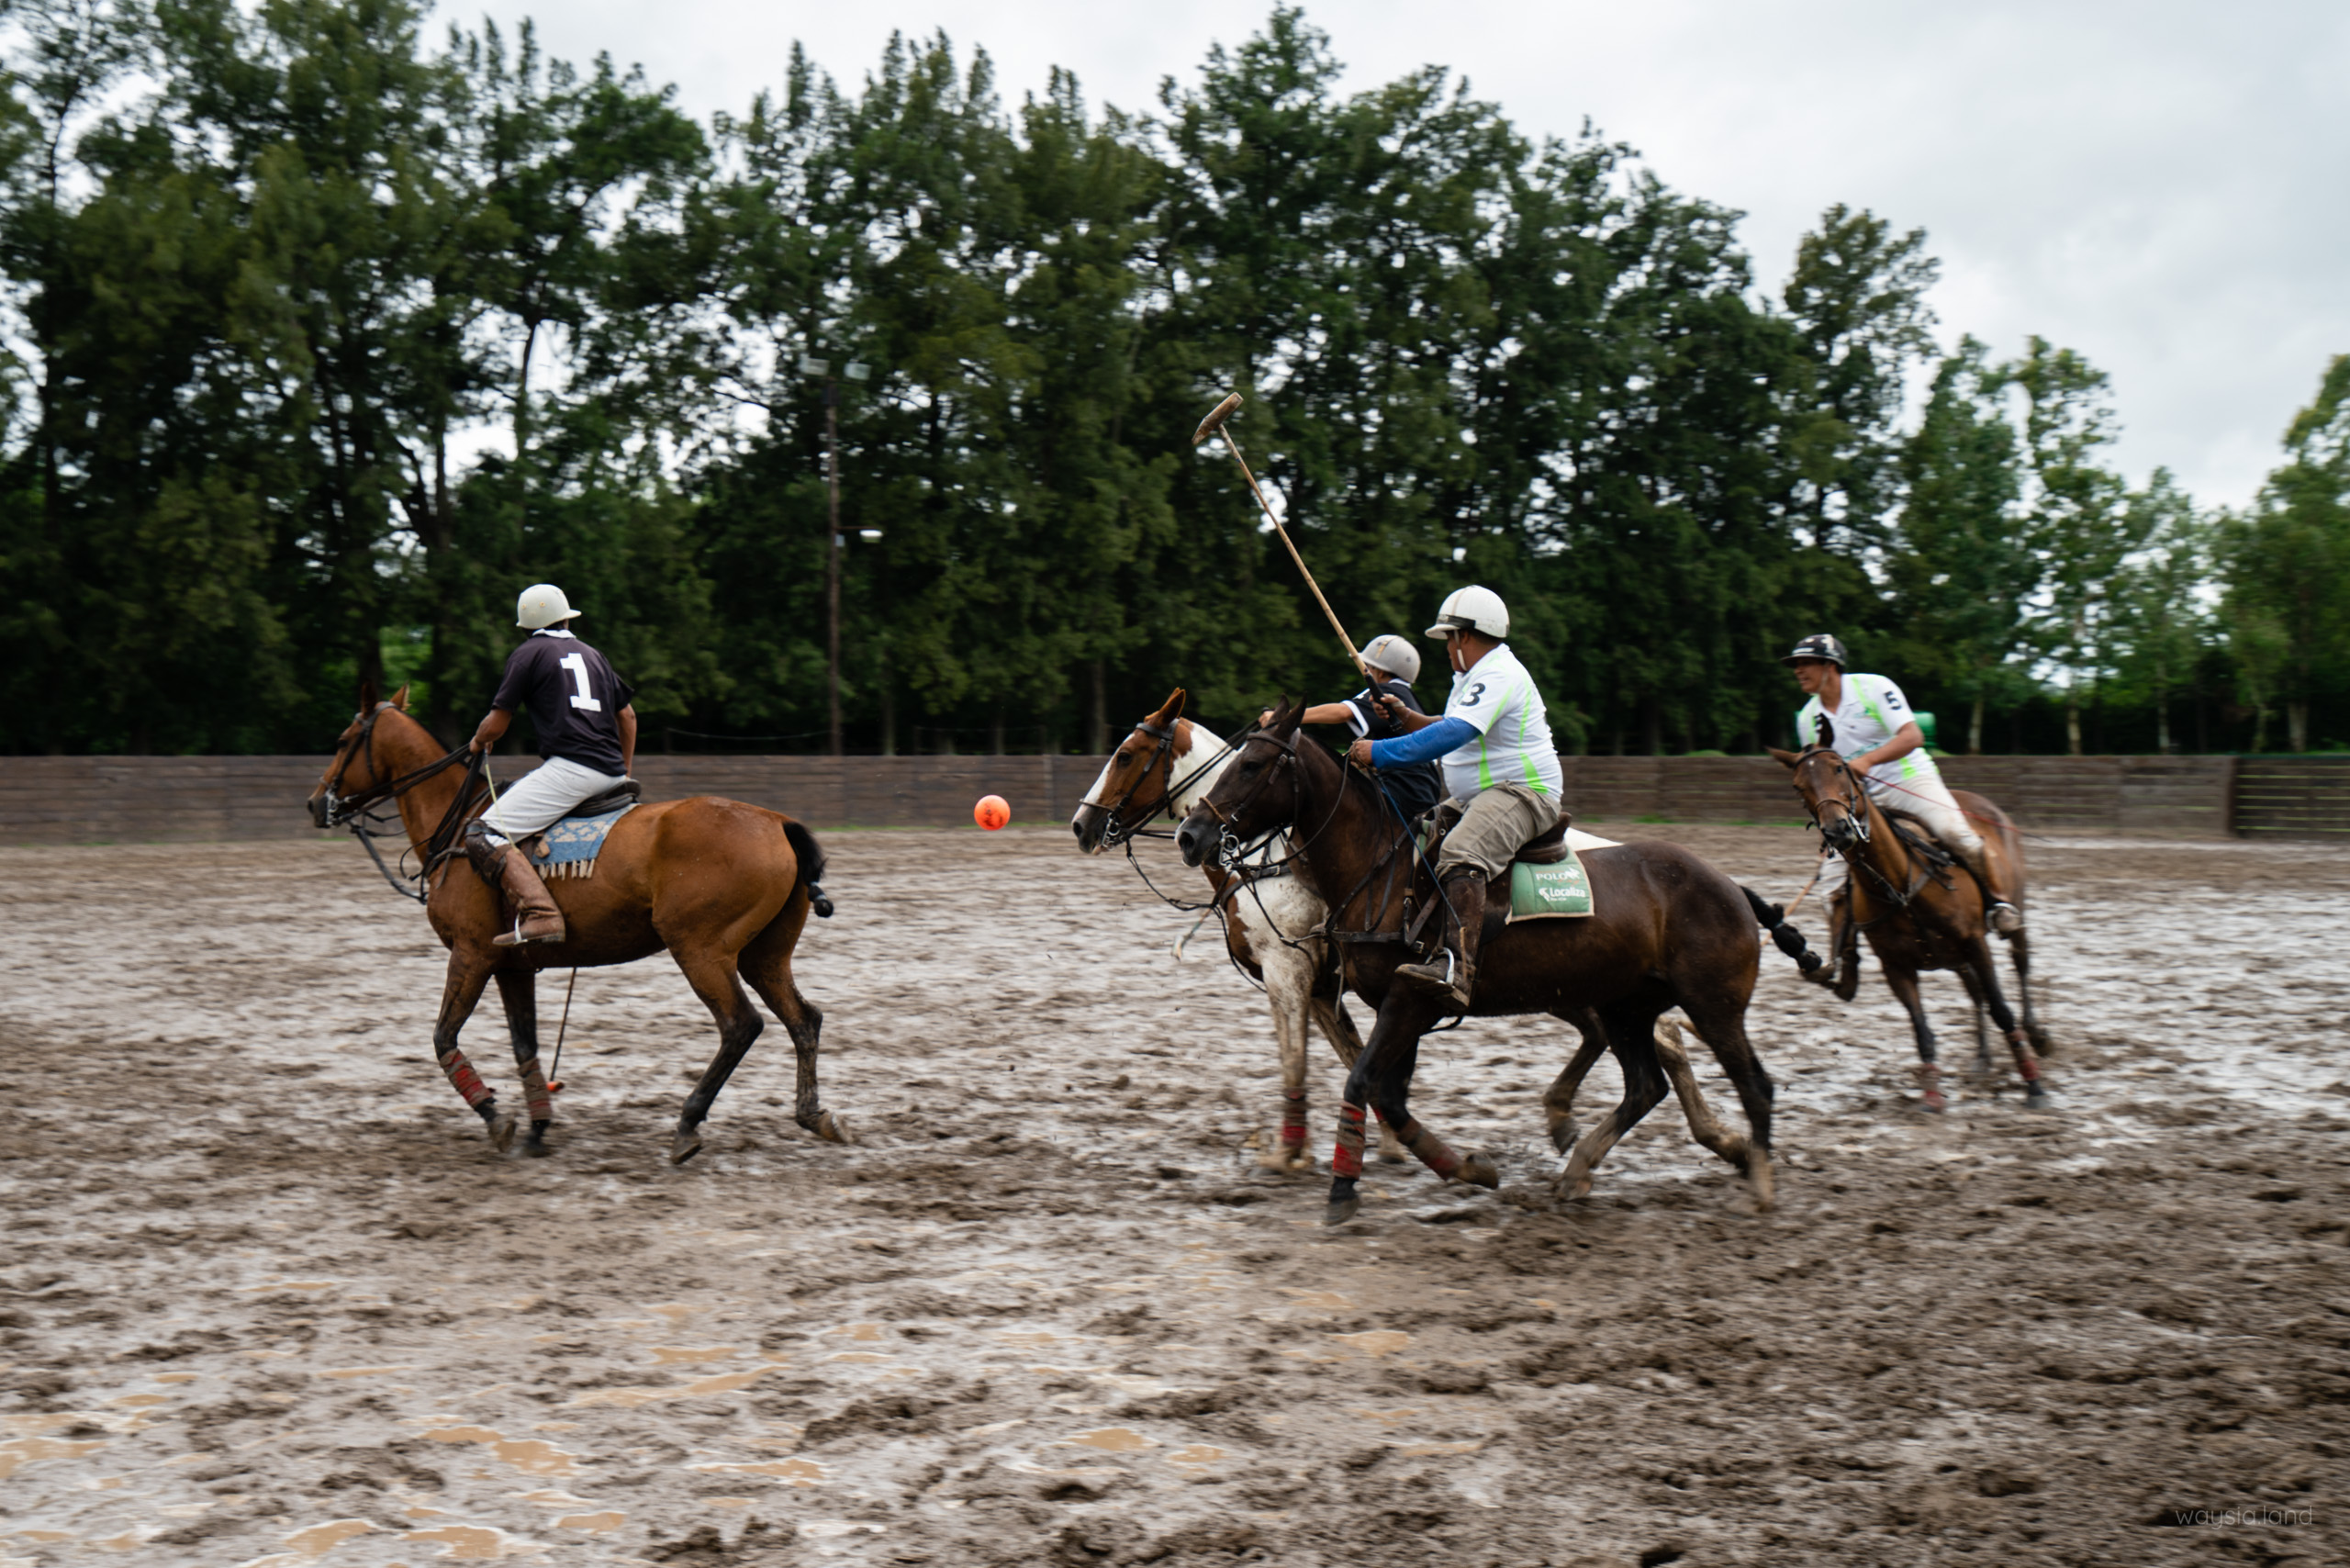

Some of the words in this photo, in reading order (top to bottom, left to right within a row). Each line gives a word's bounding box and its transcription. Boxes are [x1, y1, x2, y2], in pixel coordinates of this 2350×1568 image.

[559, 652, 602, 712] 1
[1460, 682, 1486, 707] 3
[1884, 690, 1902, 711] 5
[1536, 872, 1567, 881] POLO
[1549, 886, 1586, 898] Localiza
